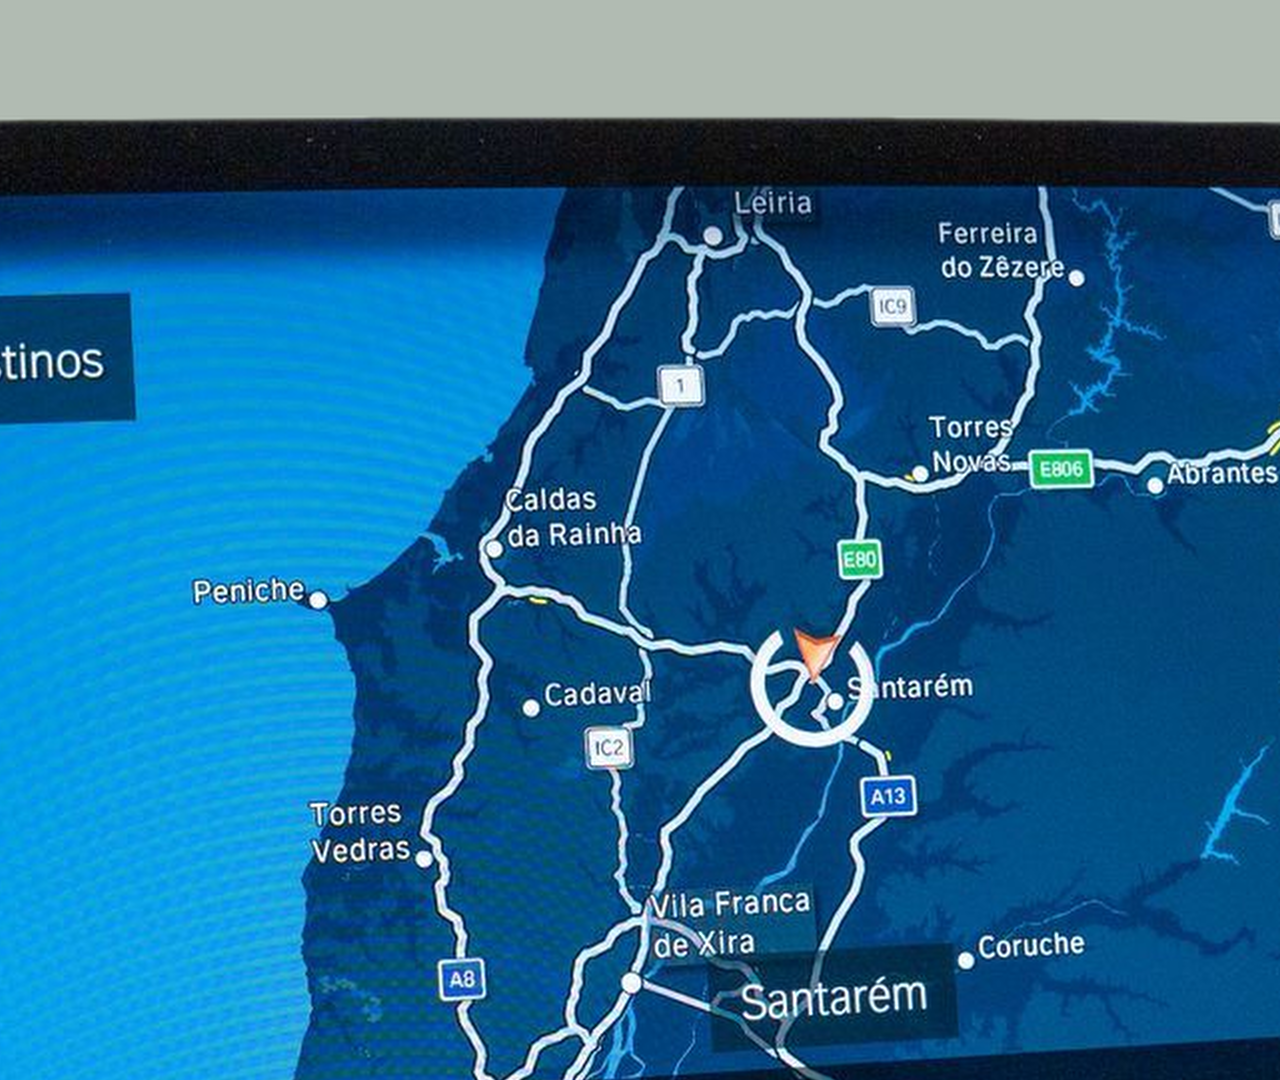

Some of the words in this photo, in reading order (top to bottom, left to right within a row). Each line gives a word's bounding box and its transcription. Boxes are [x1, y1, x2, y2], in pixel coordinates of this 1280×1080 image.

[734, 190, 812, 214] Leiria
[938, 222, 1039, 246] Ferreira
[941, 255, 972, 279] do
[979, 254, 1066, 279] Zêzere
[878, 298, 907, 315] IC9
[928, 415, 1015, 439] Torres
[932, 450, 1012, 473] Novas
[1039, 460, 1084, 479] E806
[1167, 461, 1279, 486] Abrantes
[505, 487, 597, 512] Caldas
[508, 523, 540, 549] da
[550, 521, 643, 547] Rainha
[843, 551, 877, 568] E80
[192, 577, 306, 605] Peniche
[544, 681, 651, 706] Cadaval
[595, 740, 623, 756] IC2
[870, 788, 906, 805] A13
[310, 801, 402, 826] Torres
[312, 837, 410, 864] Vedras
[650, 893, 704, 919] Vila
[715, 890, 810, 915] Franca
[654, 932, 688, 959] de
[699, 930, 755, 957] Xira
[978, 932, 1085, 960] Coruche
[449, 971, 475, 988] A8
[741, 976, 926, 1021] Santarém
